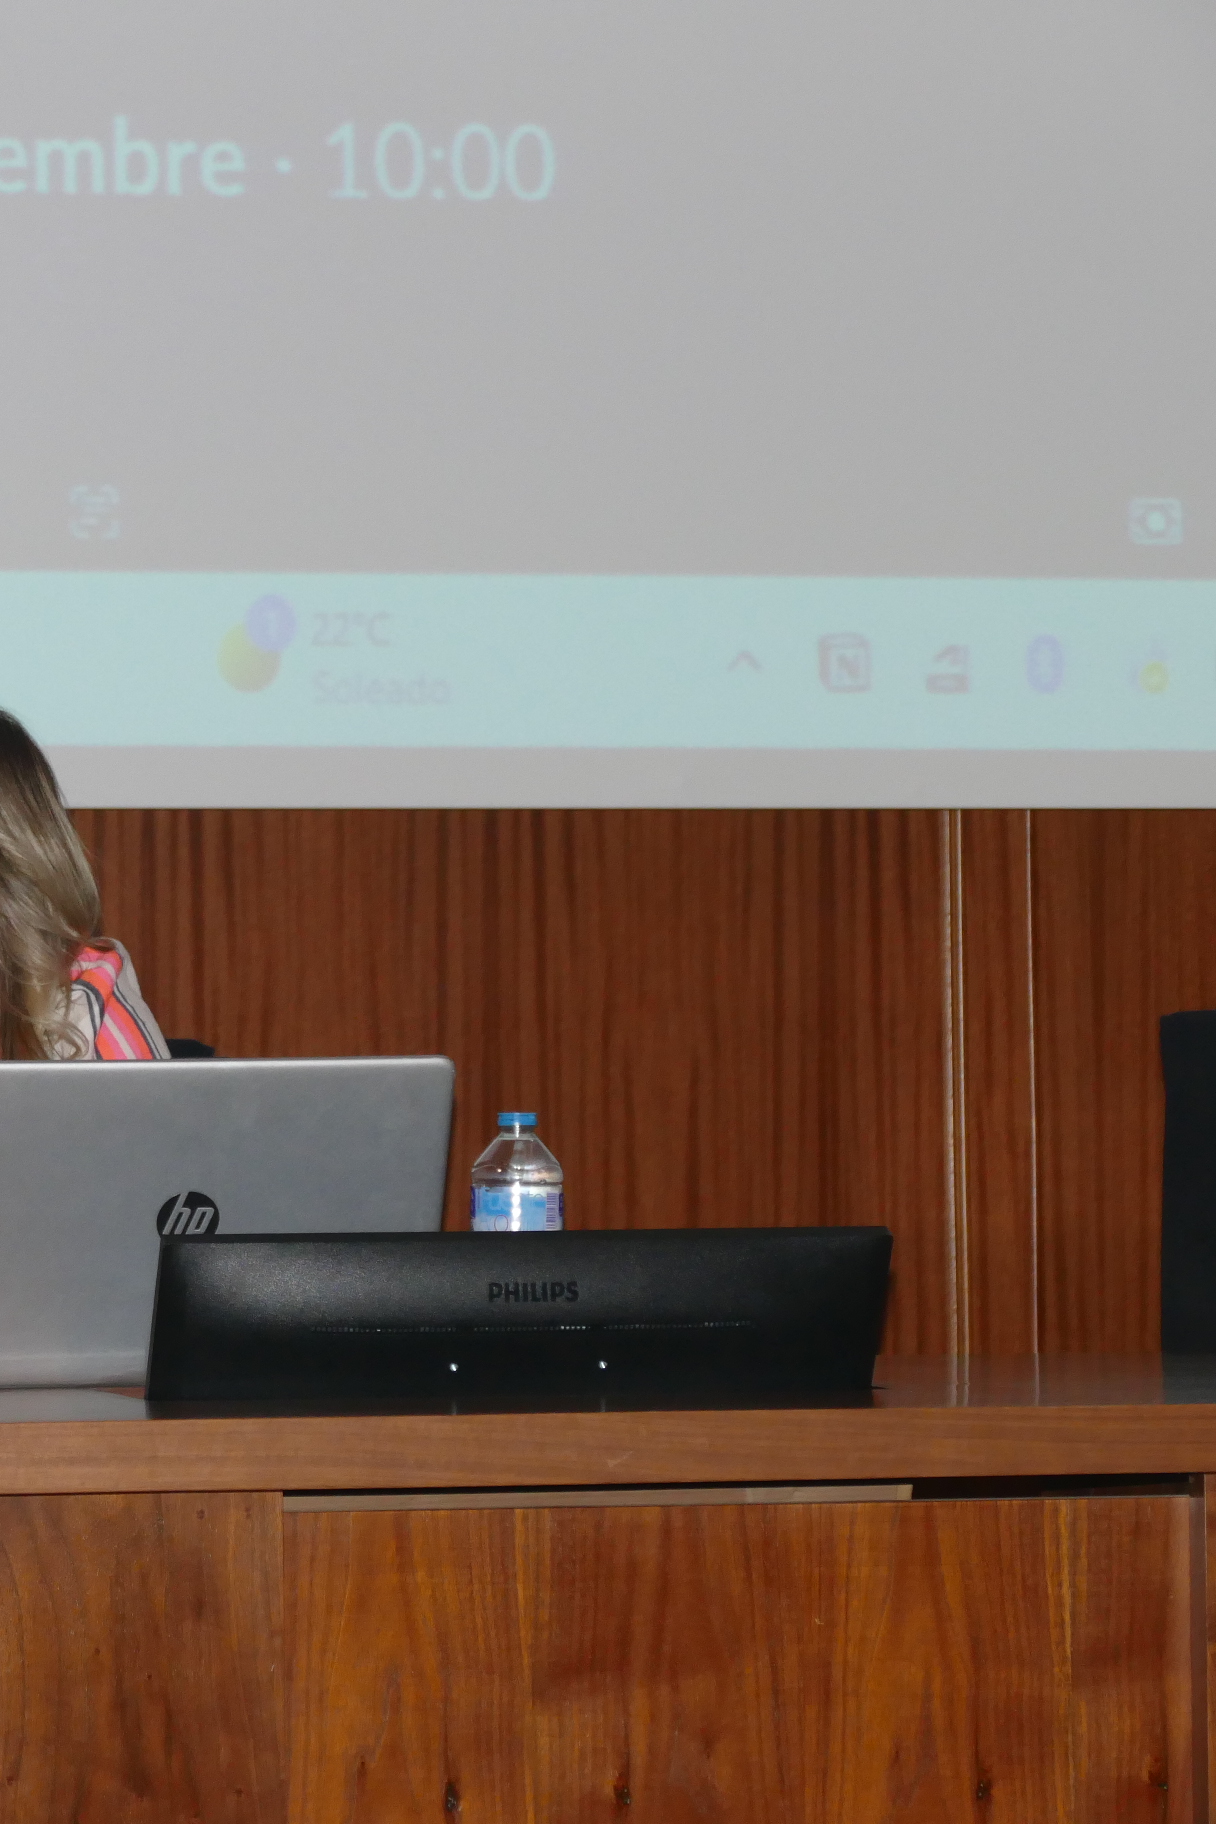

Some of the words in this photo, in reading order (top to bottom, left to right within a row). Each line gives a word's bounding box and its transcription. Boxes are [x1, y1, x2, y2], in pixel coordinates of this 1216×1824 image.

[325, 120, 556, 202] 10:00
[311, 668, 454, 706] Soleado
[162, 1191, 215, 1235] hp
[488, 1280, 580, 1303] PHILIPS
